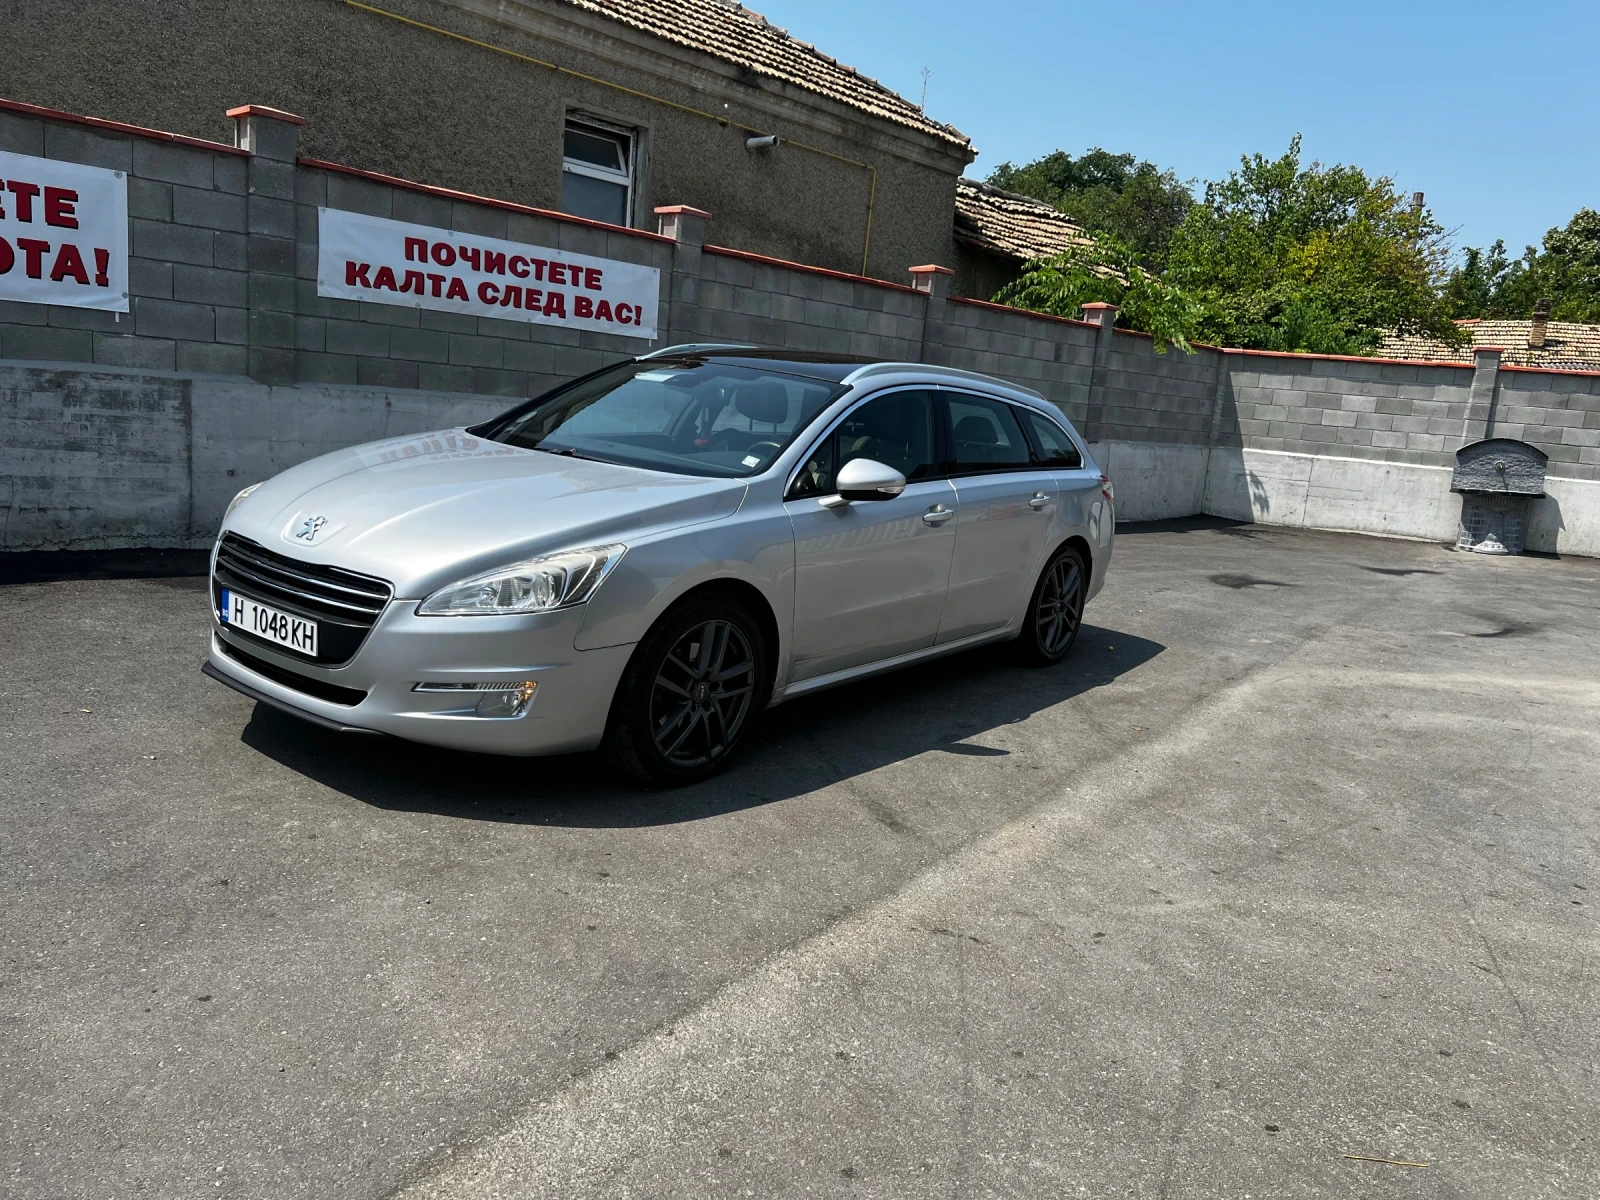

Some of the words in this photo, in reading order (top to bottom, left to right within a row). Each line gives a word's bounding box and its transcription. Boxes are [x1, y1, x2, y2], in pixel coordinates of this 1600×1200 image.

[0, 178, 79, 230] ТЕ
[404, 236, 603, 291] ПОЧИСТЕТЕ
[345, 260, 470, 302] КАЛТА
[477, 281, 567, 319] СЛЕД
[573, 295, 643, 327] ВАС!
